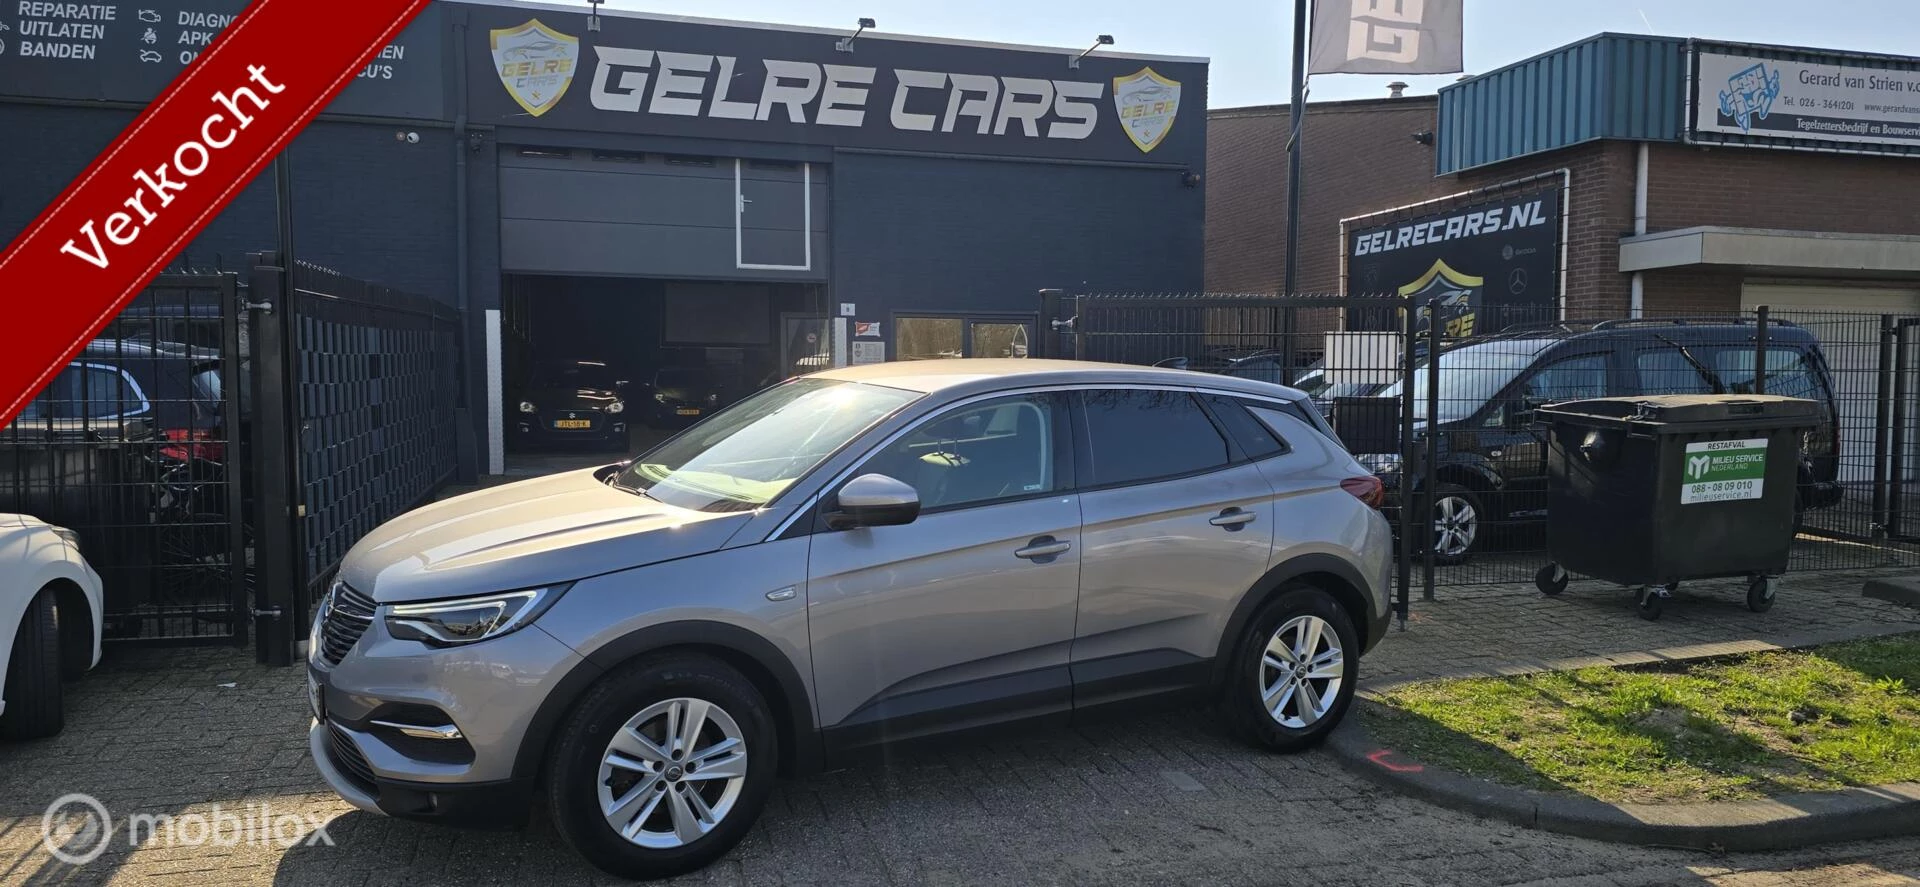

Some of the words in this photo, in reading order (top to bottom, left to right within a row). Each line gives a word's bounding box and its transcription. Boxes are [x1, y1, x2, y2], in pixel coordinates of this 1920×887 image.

[19, 1, 116, 20] REPARATIE
[20, 20, 104, 39] UITLATEN
[178, 31, 213, 46] APK
[20, 41, 95, 59] BANDEN
[377, 45, 404, 59] EN
[502, 60, 573, 77] GELRE
[1799, 69, 1841, 87] Gerard
[1845, 77, 1865, 89] van
[1869, 75, 1903, 92] Strien
[590, 46, 877, 127] GELRE
[890, 69, 1105, 140] CARS
[1121, 101, 1176, 118] GELRE
[1799, 97, 1815, 107] 026
[1796, 118, 1868, 134] Tegelzettersbedrijf
[1870, 126, 1881, 134] en
[1355, 201, 1546, 257] GELRECARS.NL
[1708, 441, 1745, 450] RESTAFVAL
[1711, 463, 1748, 471] NEDERLAND
[1713, 456, 1735, 464] MILIEU
[1735, 454, 1763, 463] SERVICE
[1691, 484, 1706, 493] 088
[1713, 482, 1722, 491] 08
[1724, 482, 1734, 490] 09
[1737, 481, 1752, 489] 010
[1691, 490, 1752, 502] milieuservice.nl
